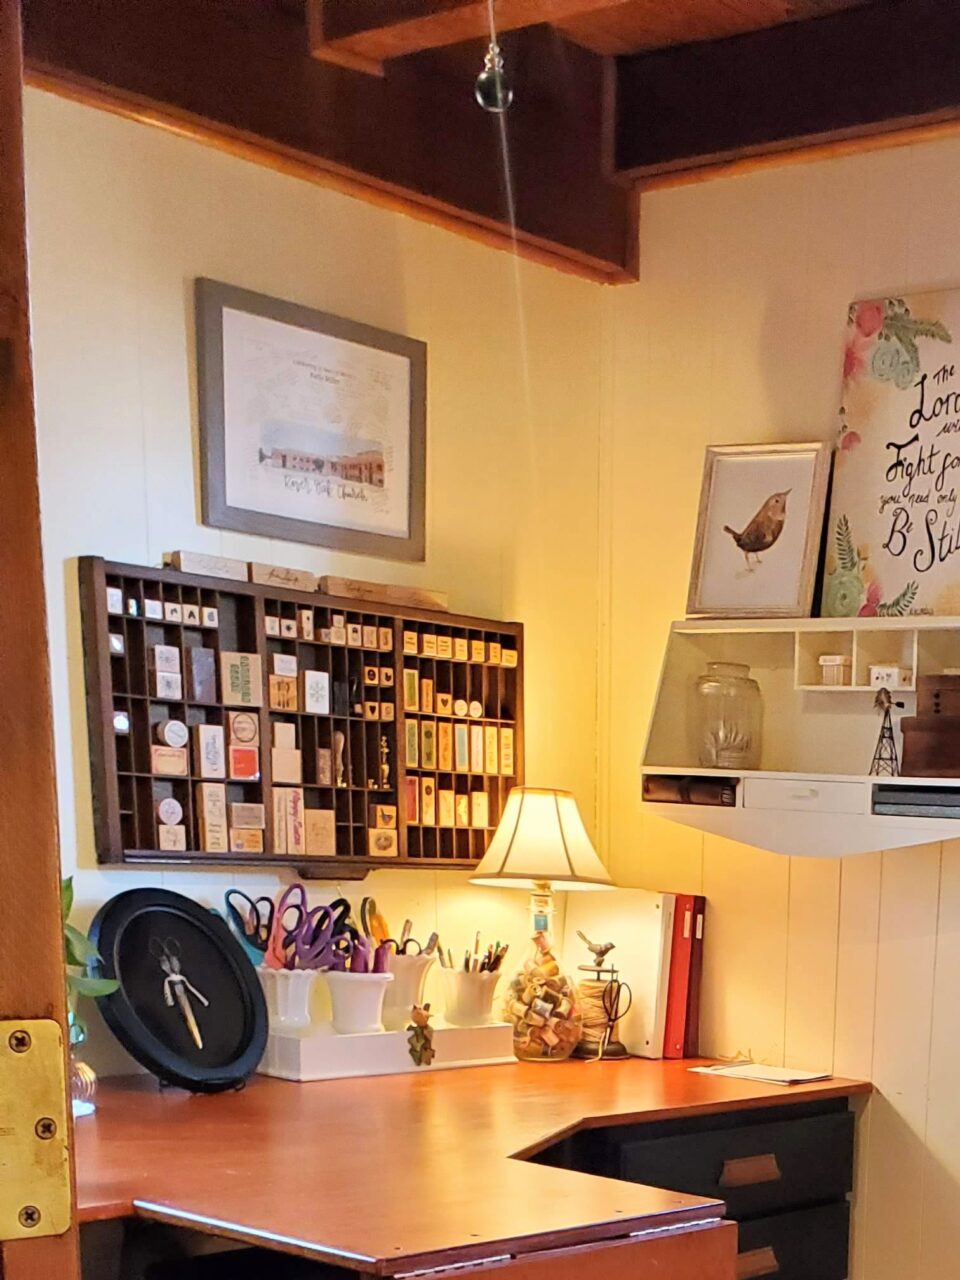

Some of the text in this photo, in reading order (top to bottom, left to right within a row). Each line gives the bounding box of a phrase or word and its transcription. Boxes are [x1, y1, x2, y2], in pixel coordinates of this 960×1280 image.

[933, 365, 955, 385] The
[885, 432, 941, 498] Fight
[879, 494, 902, 514] you
[908, 489, 931, 507] need
[937, 488, 957, 518] only
[882, 507, 913, 557] Be
